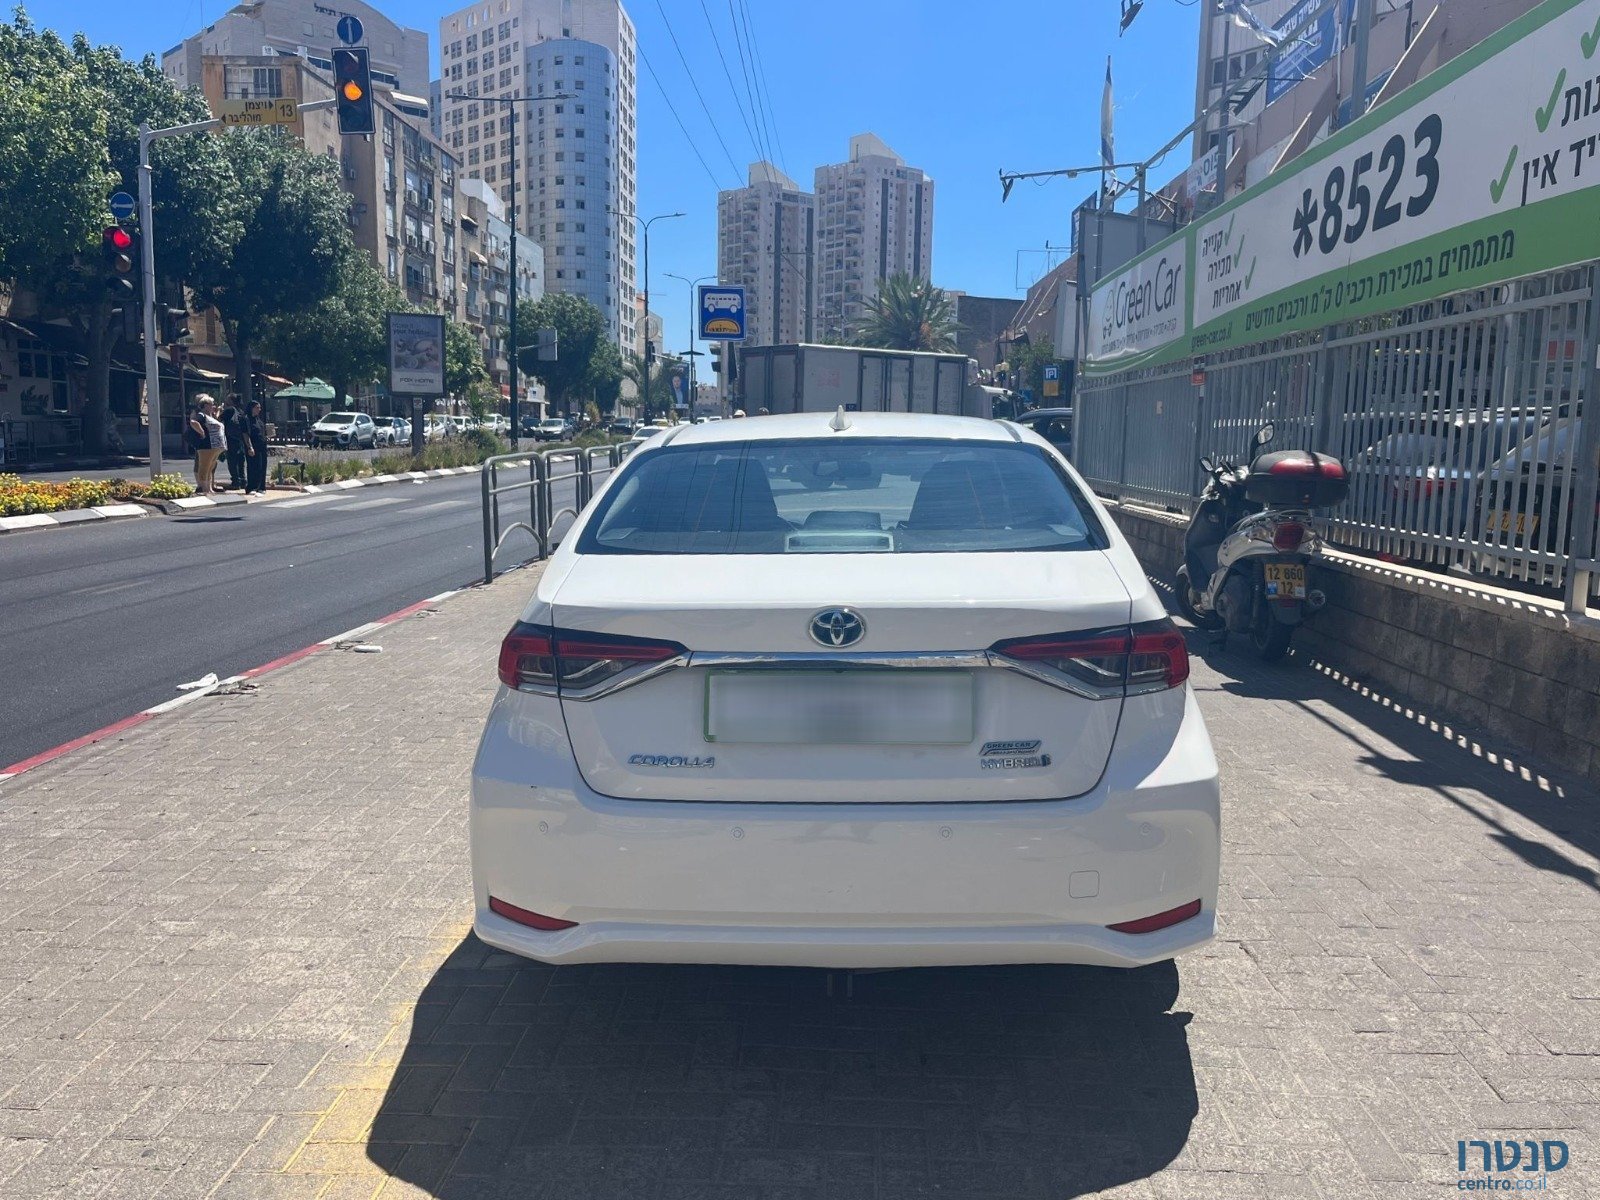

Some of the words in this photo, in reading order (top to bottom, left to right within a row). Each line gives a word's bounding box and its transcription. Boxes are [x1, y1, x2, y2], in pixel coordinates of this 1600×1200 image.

[245, 101, 267, 112] ויצמן
[280, 105, 293, 117] 13
[1521, 149, 1560, 207] אין
[1202, 230, 1223, 257] קנייה
[1438, 229, 1514, 278] מתמחים
[1208, 255, 1231, 282] מכירה
[1376, 256, 1433, 296] במכירת
[1116, 281, 1151, 328] Green
[1154, 258, 1181, 312] Car
[1213, 280, 1242, 308] אחריות
[1335, 281, 1343, 307] 0
[1347, 276, 1373, 304] רכבי
[1245, 307, 1274, 331] חדשים
[1277, 296, 1308, 323] ורכבים
[1268, 567, 1280, 580] 12
[628, 754, 715, 768] COROLLA
[981, 757, 1041, 769] HYBRID
